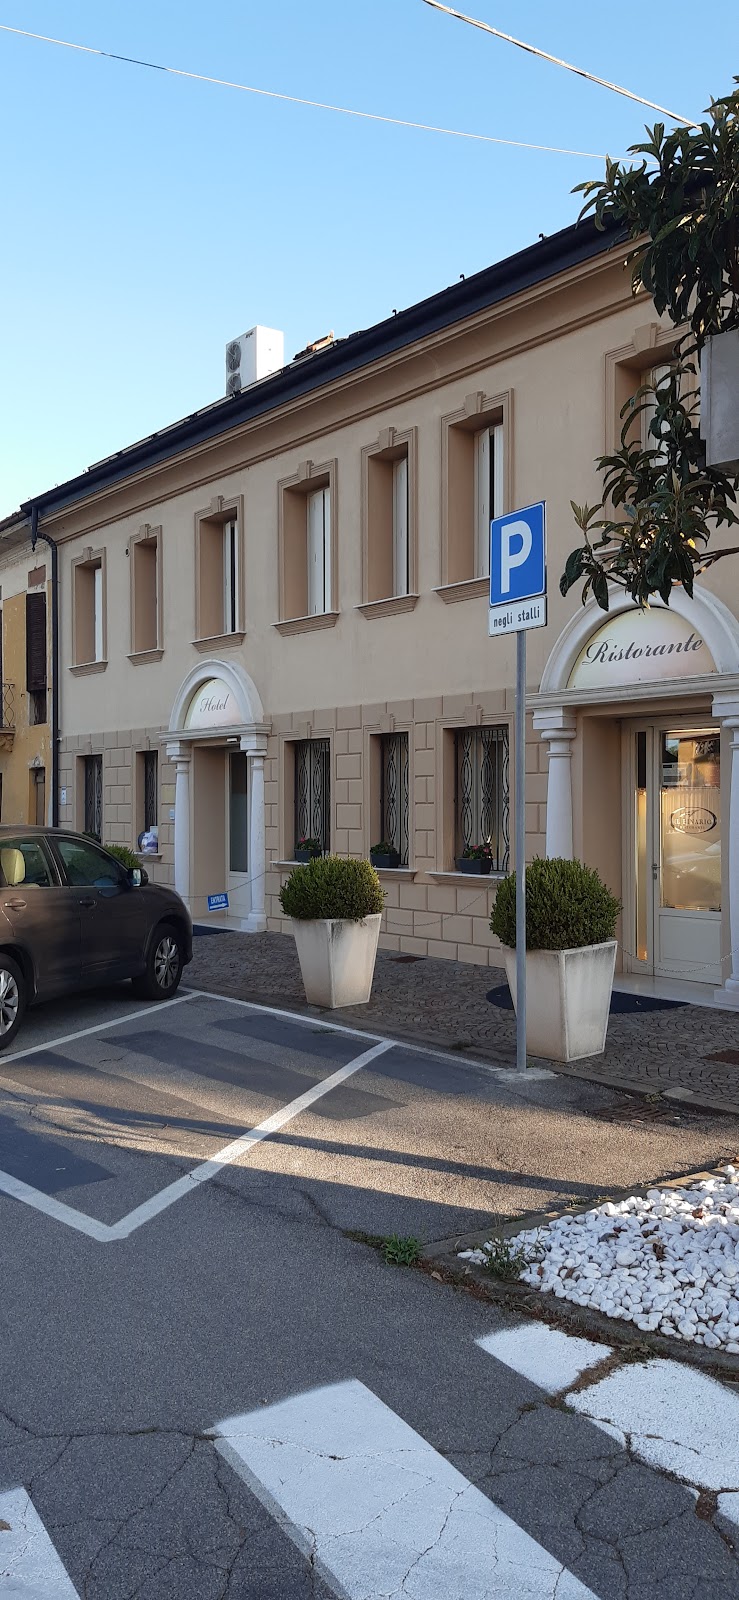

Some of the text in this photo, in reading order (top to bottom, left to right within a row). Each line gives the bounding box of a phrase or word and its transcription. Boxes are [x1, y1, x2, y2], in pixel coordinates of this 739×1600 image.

[500, 520, 533, 594] P
[493, 606, 540, 628] negli stalli
[582, 633, 704, 665] Ristorante
[200, 694, 230, 712] Hotel
